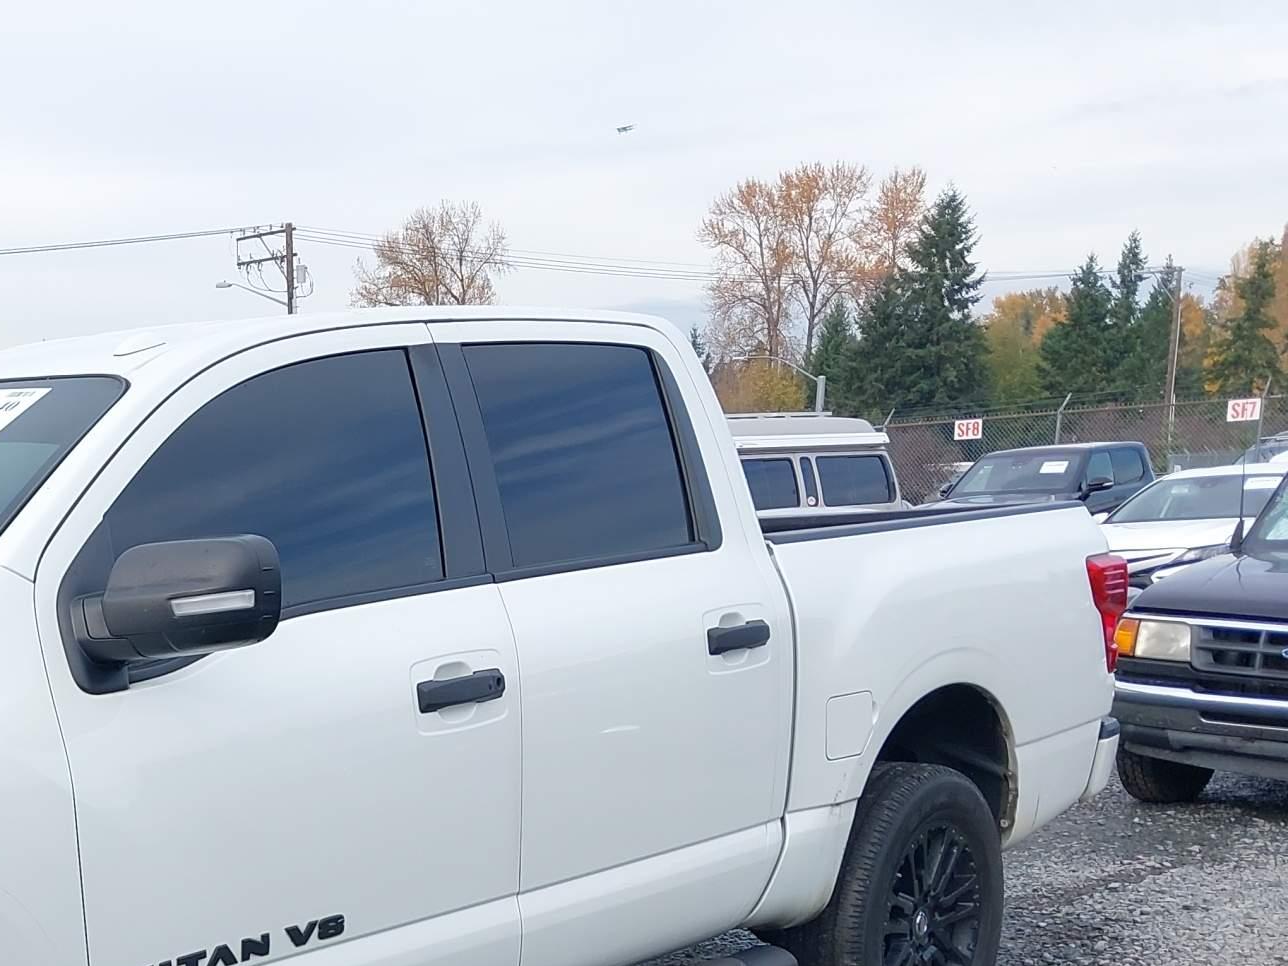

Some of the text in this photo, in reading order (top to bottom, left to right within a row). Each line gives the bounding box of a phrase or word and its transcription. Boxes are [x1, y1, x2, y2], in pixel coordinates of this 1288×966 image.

[1231, 401, 1257, 419] SF7
[957, 421, 980, 438] SF8
[283, 913, 346, 948] V8
